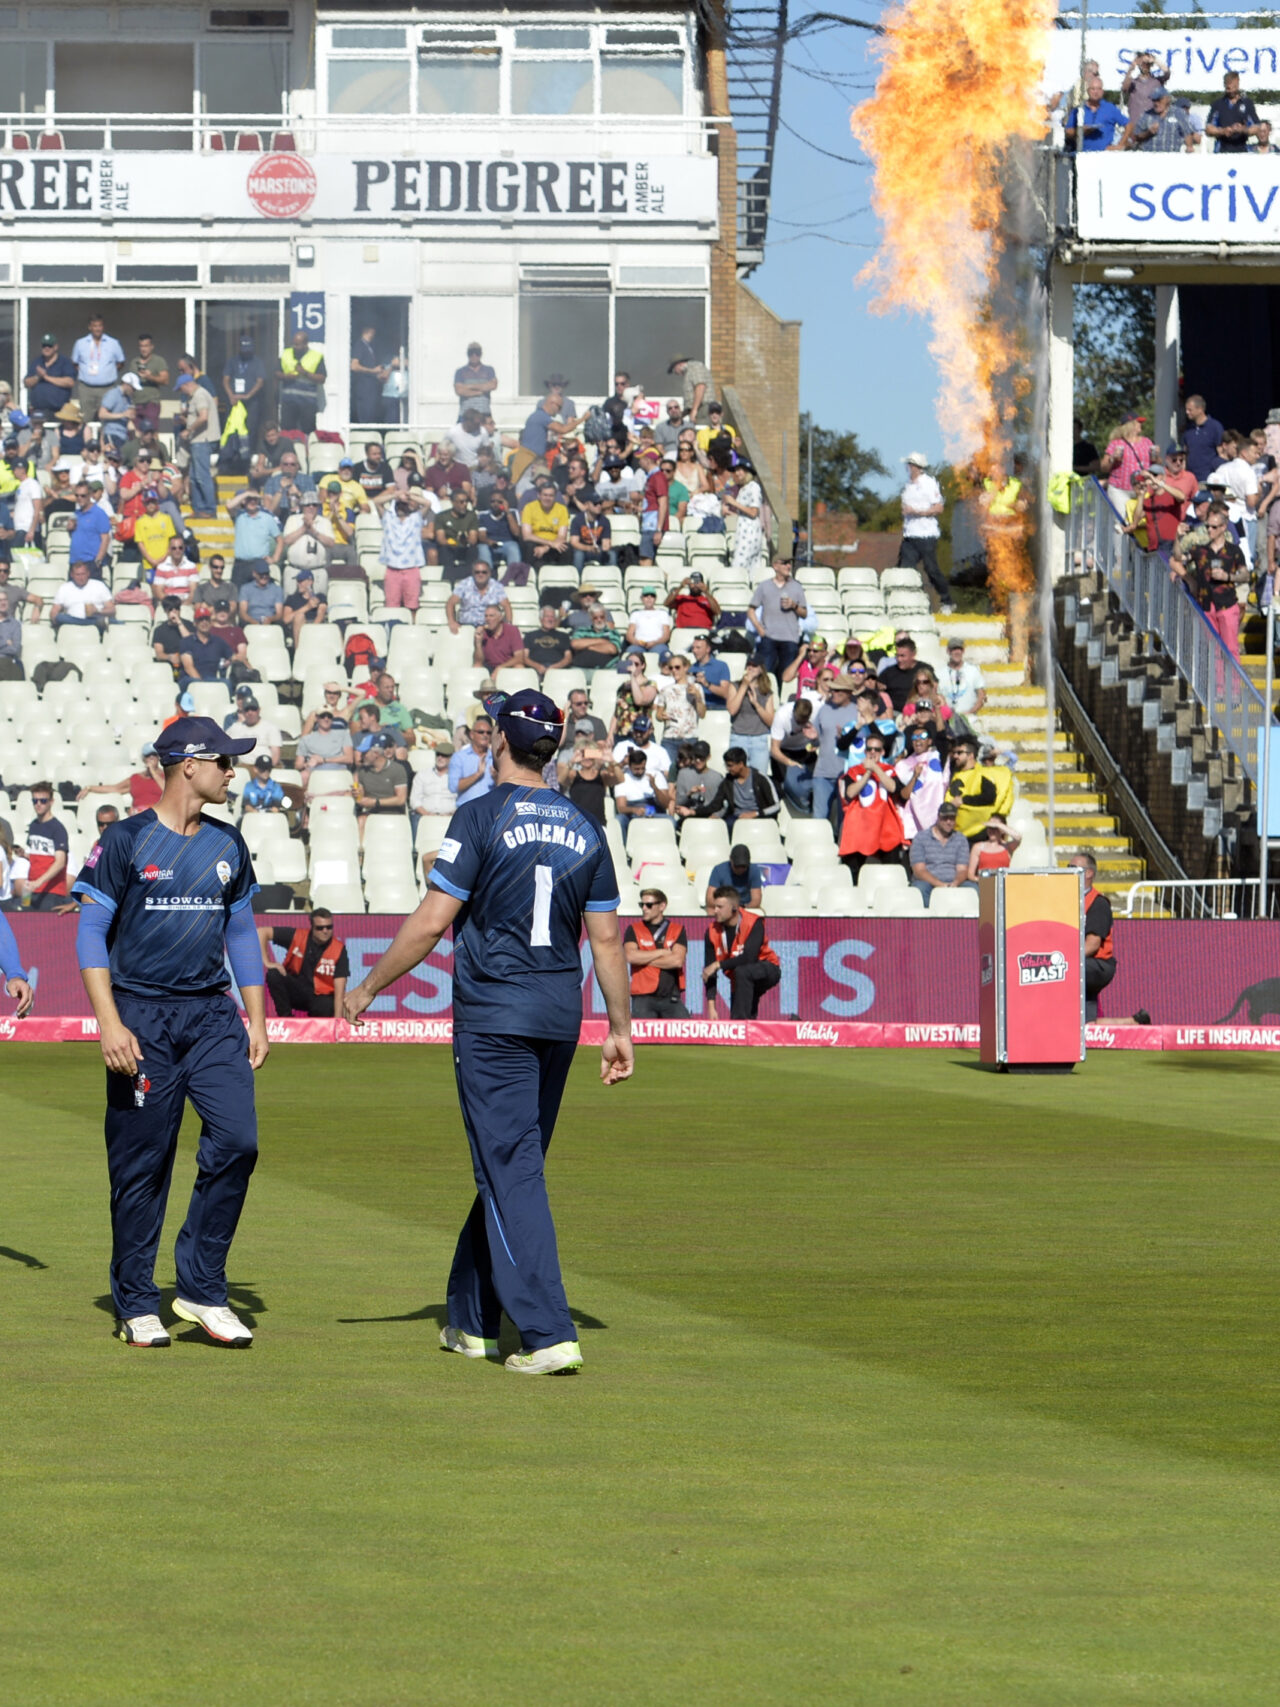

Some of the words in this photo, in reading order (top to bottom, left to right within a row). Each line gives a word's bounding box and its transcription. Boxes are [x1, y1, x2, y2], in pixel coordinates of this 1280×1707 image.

[100, 159, 113, 211] AMBER
[117, 182, 130, 211] ALE
[351, 160, 628, 214] PEDIGREE
[635, 161, 649, 213] AMBER
[652, 184, 665, 213] ALE
[291, 303, 324, 330] 15
[537, 807, 570, 820] DERBY
[502, 822, 587, 856] GODLEMAN
[145, 896, 224, 906] SHOWCAS
[530, 864, 553, 947] 1
[1021, 963, 1066, 984] BLAST
[349, 1022, 378, 1037] LIFE
[666, 1022, 746, 1039] INSURANCE
[795, 1021, 840, 1044] Vitality
[1176, 1029, 1205, 1045] LIFE
